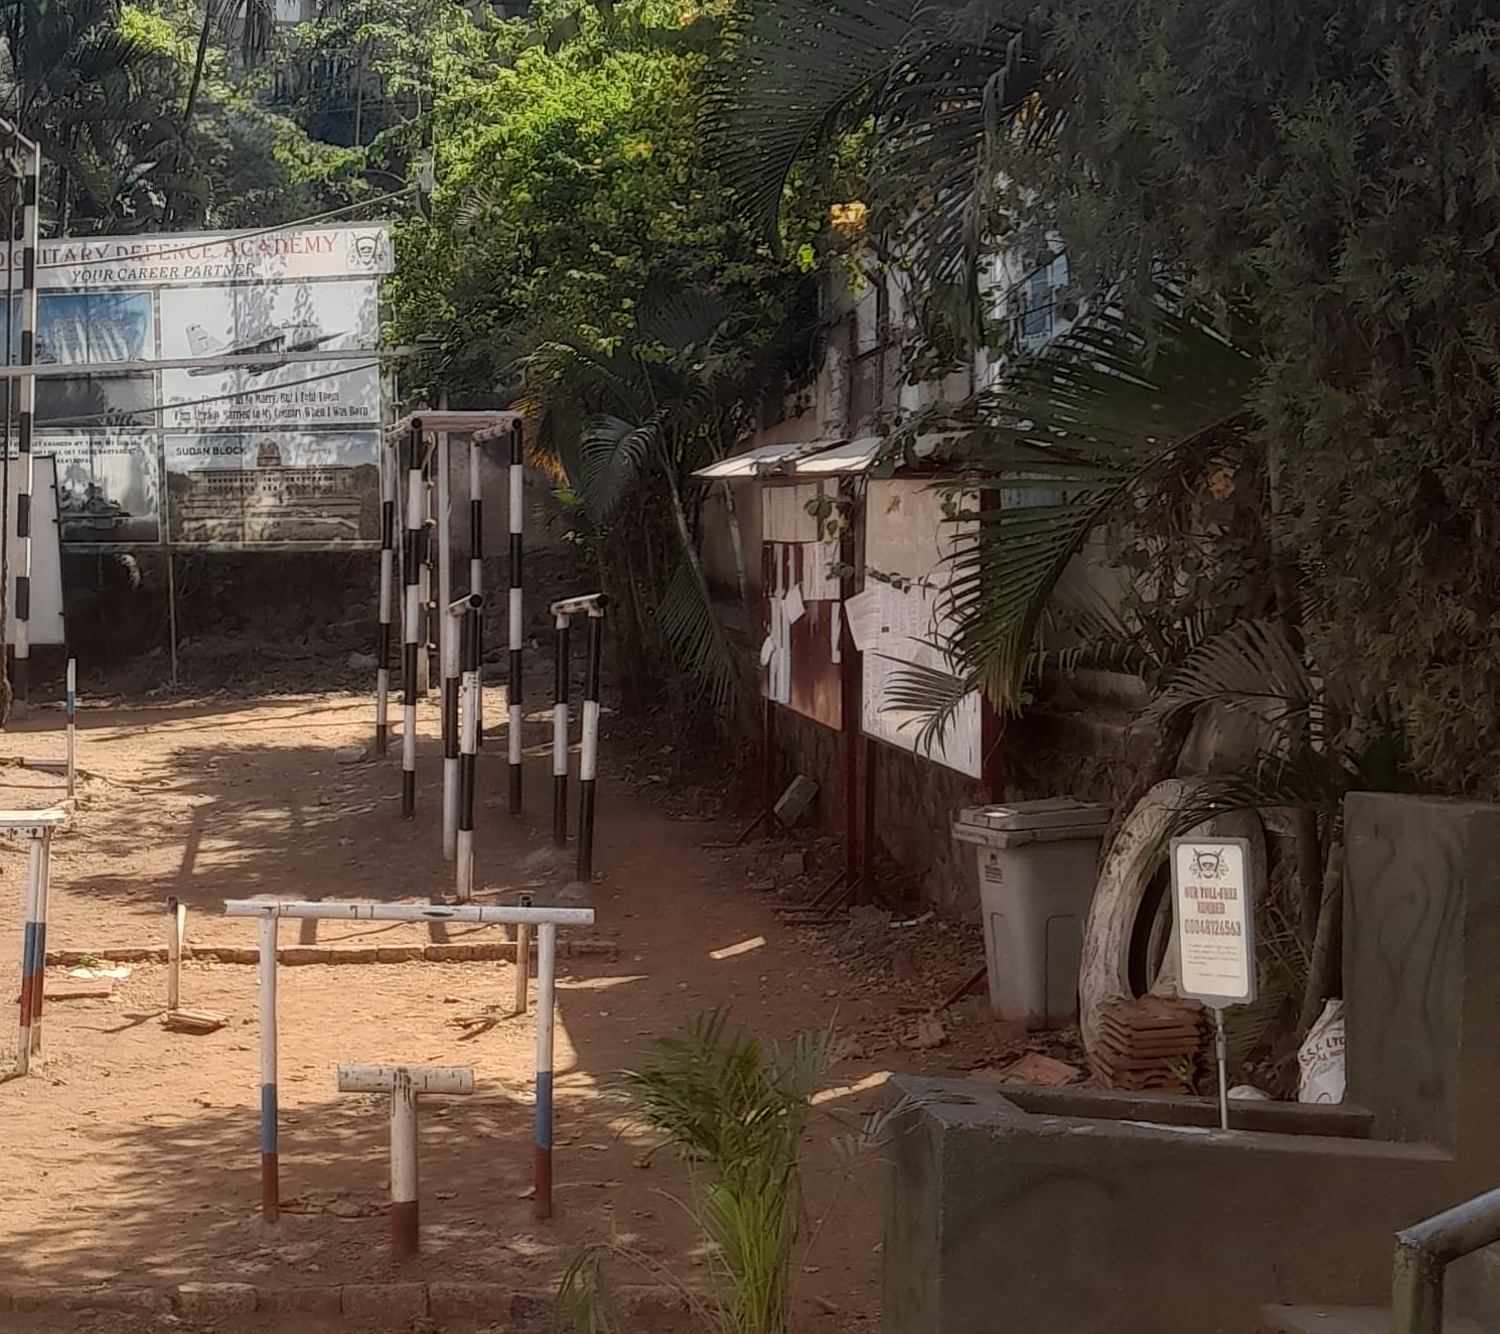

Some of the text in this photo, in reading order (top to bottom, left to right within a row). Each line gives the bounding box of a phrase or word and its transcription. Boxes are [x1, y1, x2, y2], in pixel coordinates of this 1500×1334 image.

[116, 240, 216, 262] DEFENCE
[223, 232, 339, 259] ACADEMY
[72, 263, 256, 283] YOUR CAREER PARTNER
[175, 445, 247, 456] SUDAN BLOCK
